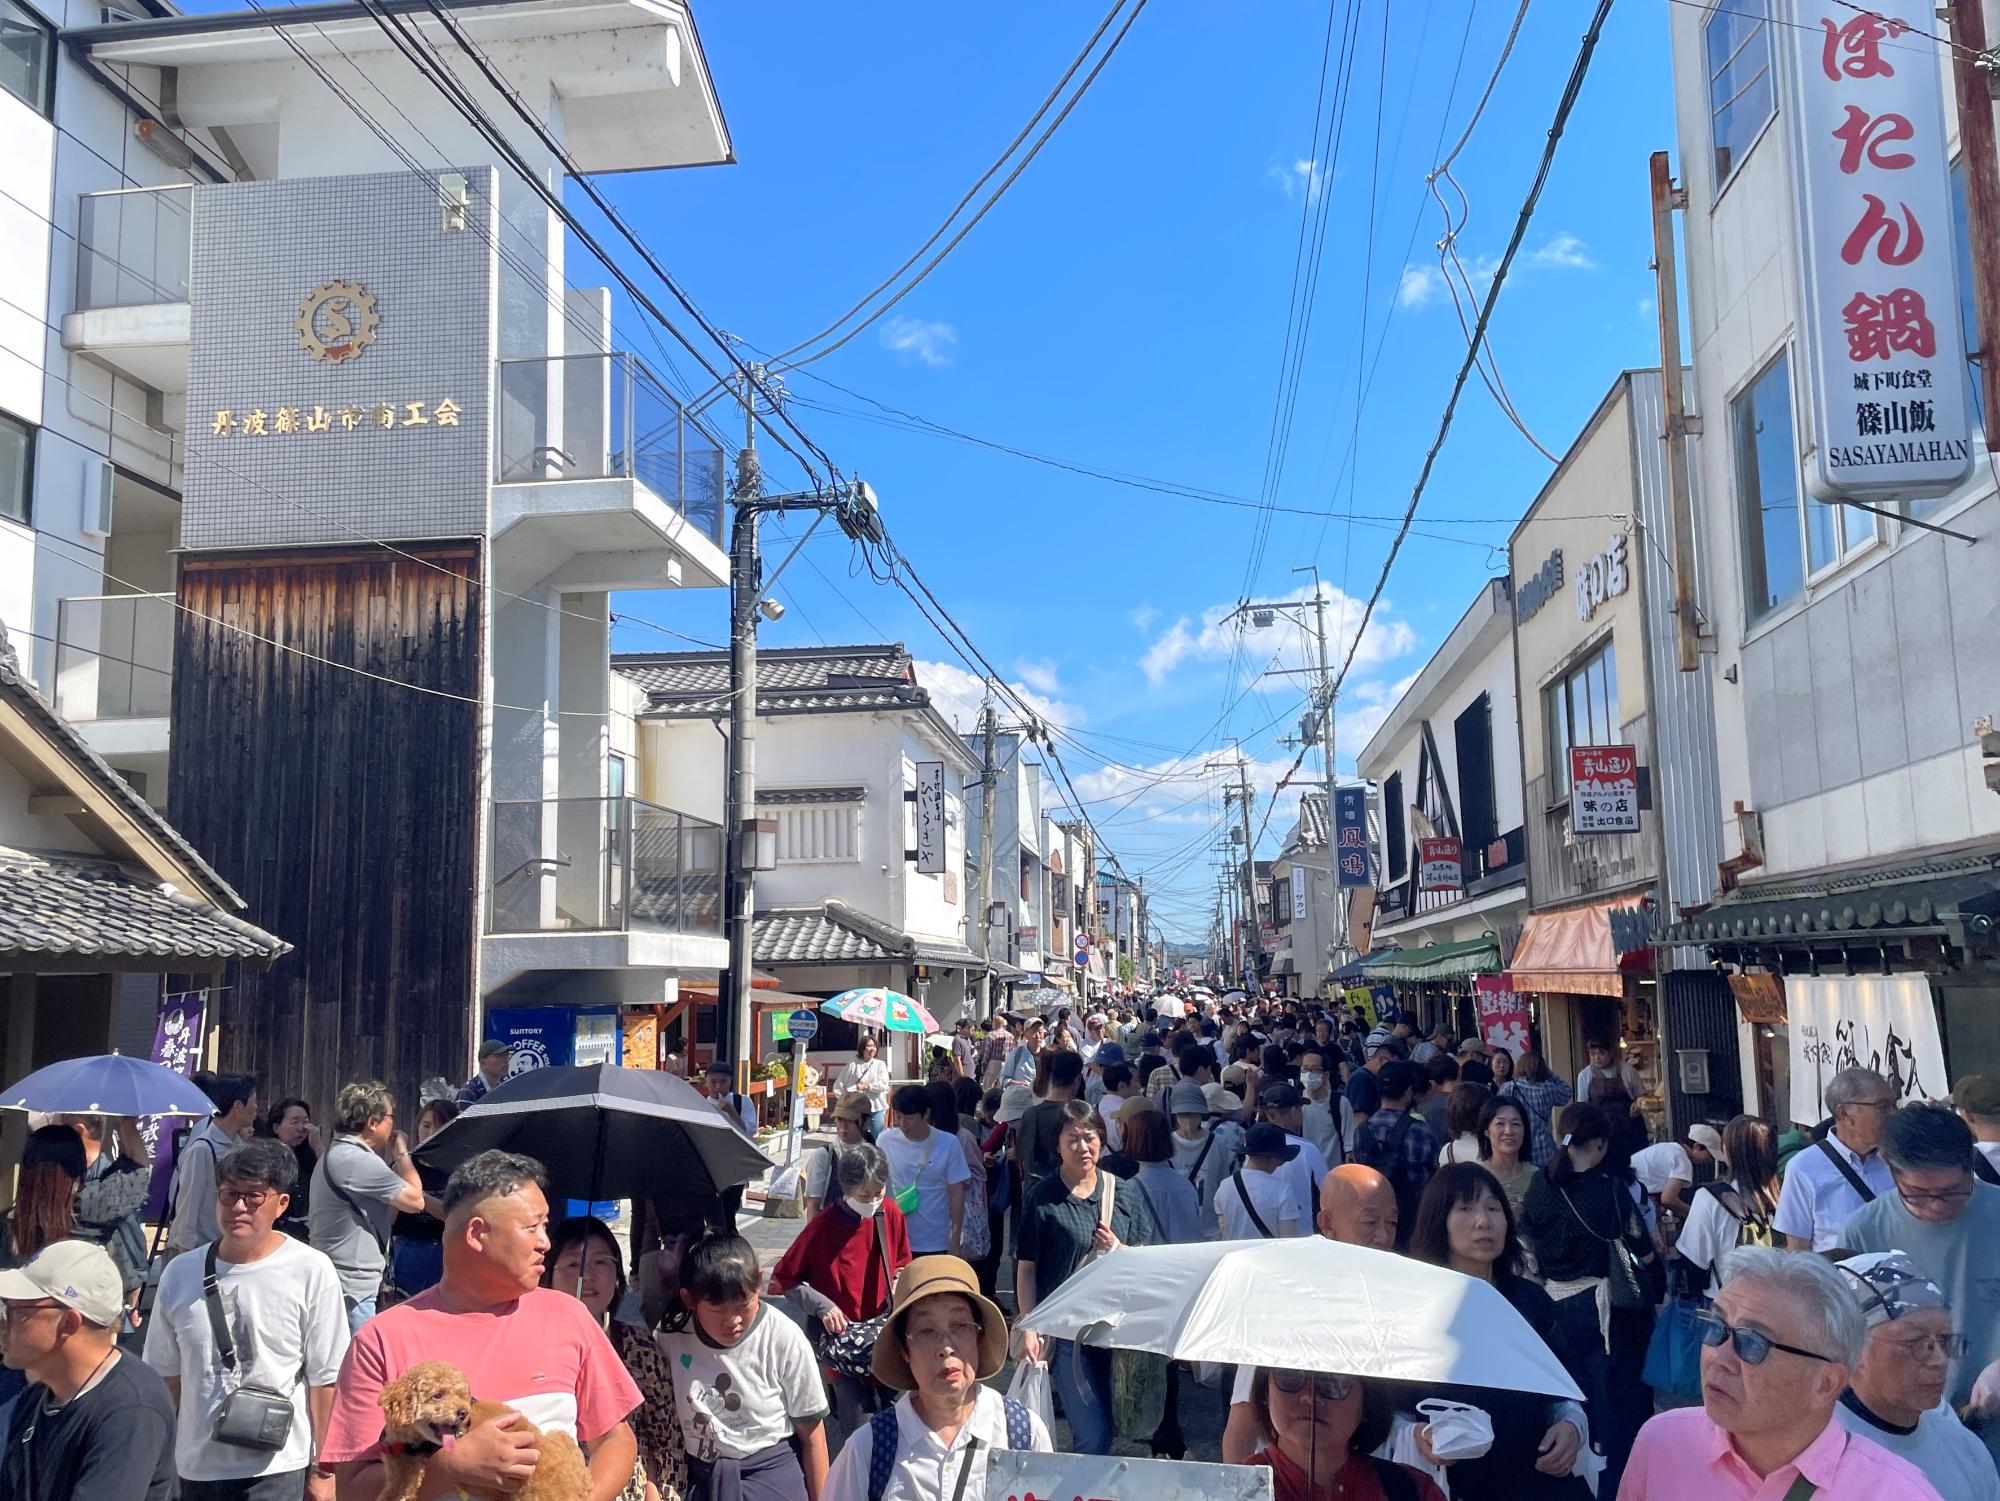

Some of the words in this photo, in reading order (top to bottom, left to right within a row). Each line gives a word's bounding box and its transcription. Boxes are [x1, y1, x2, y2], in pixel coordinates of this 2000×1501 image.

[1821, 12, 1936, 362] ぼたん鍋
[1854, 369, 1933, 392] 城下町食堂
[211, 397, 462, 438] 丹波篠山市商工会
[1856, 399, 1936, 437] 篠山飯
[1829, 439, 1968, 468] SASAYAMAHAN
[1583, 757, 1631, 777] 青山通り
[1584, 799, 1628, 812] 味の店
[921, 782, 934, 865] ひいらぎや
[1338, 827, 1366, 876] 鳳鳴
[508, 1038, 547, 1054] OFFEE
